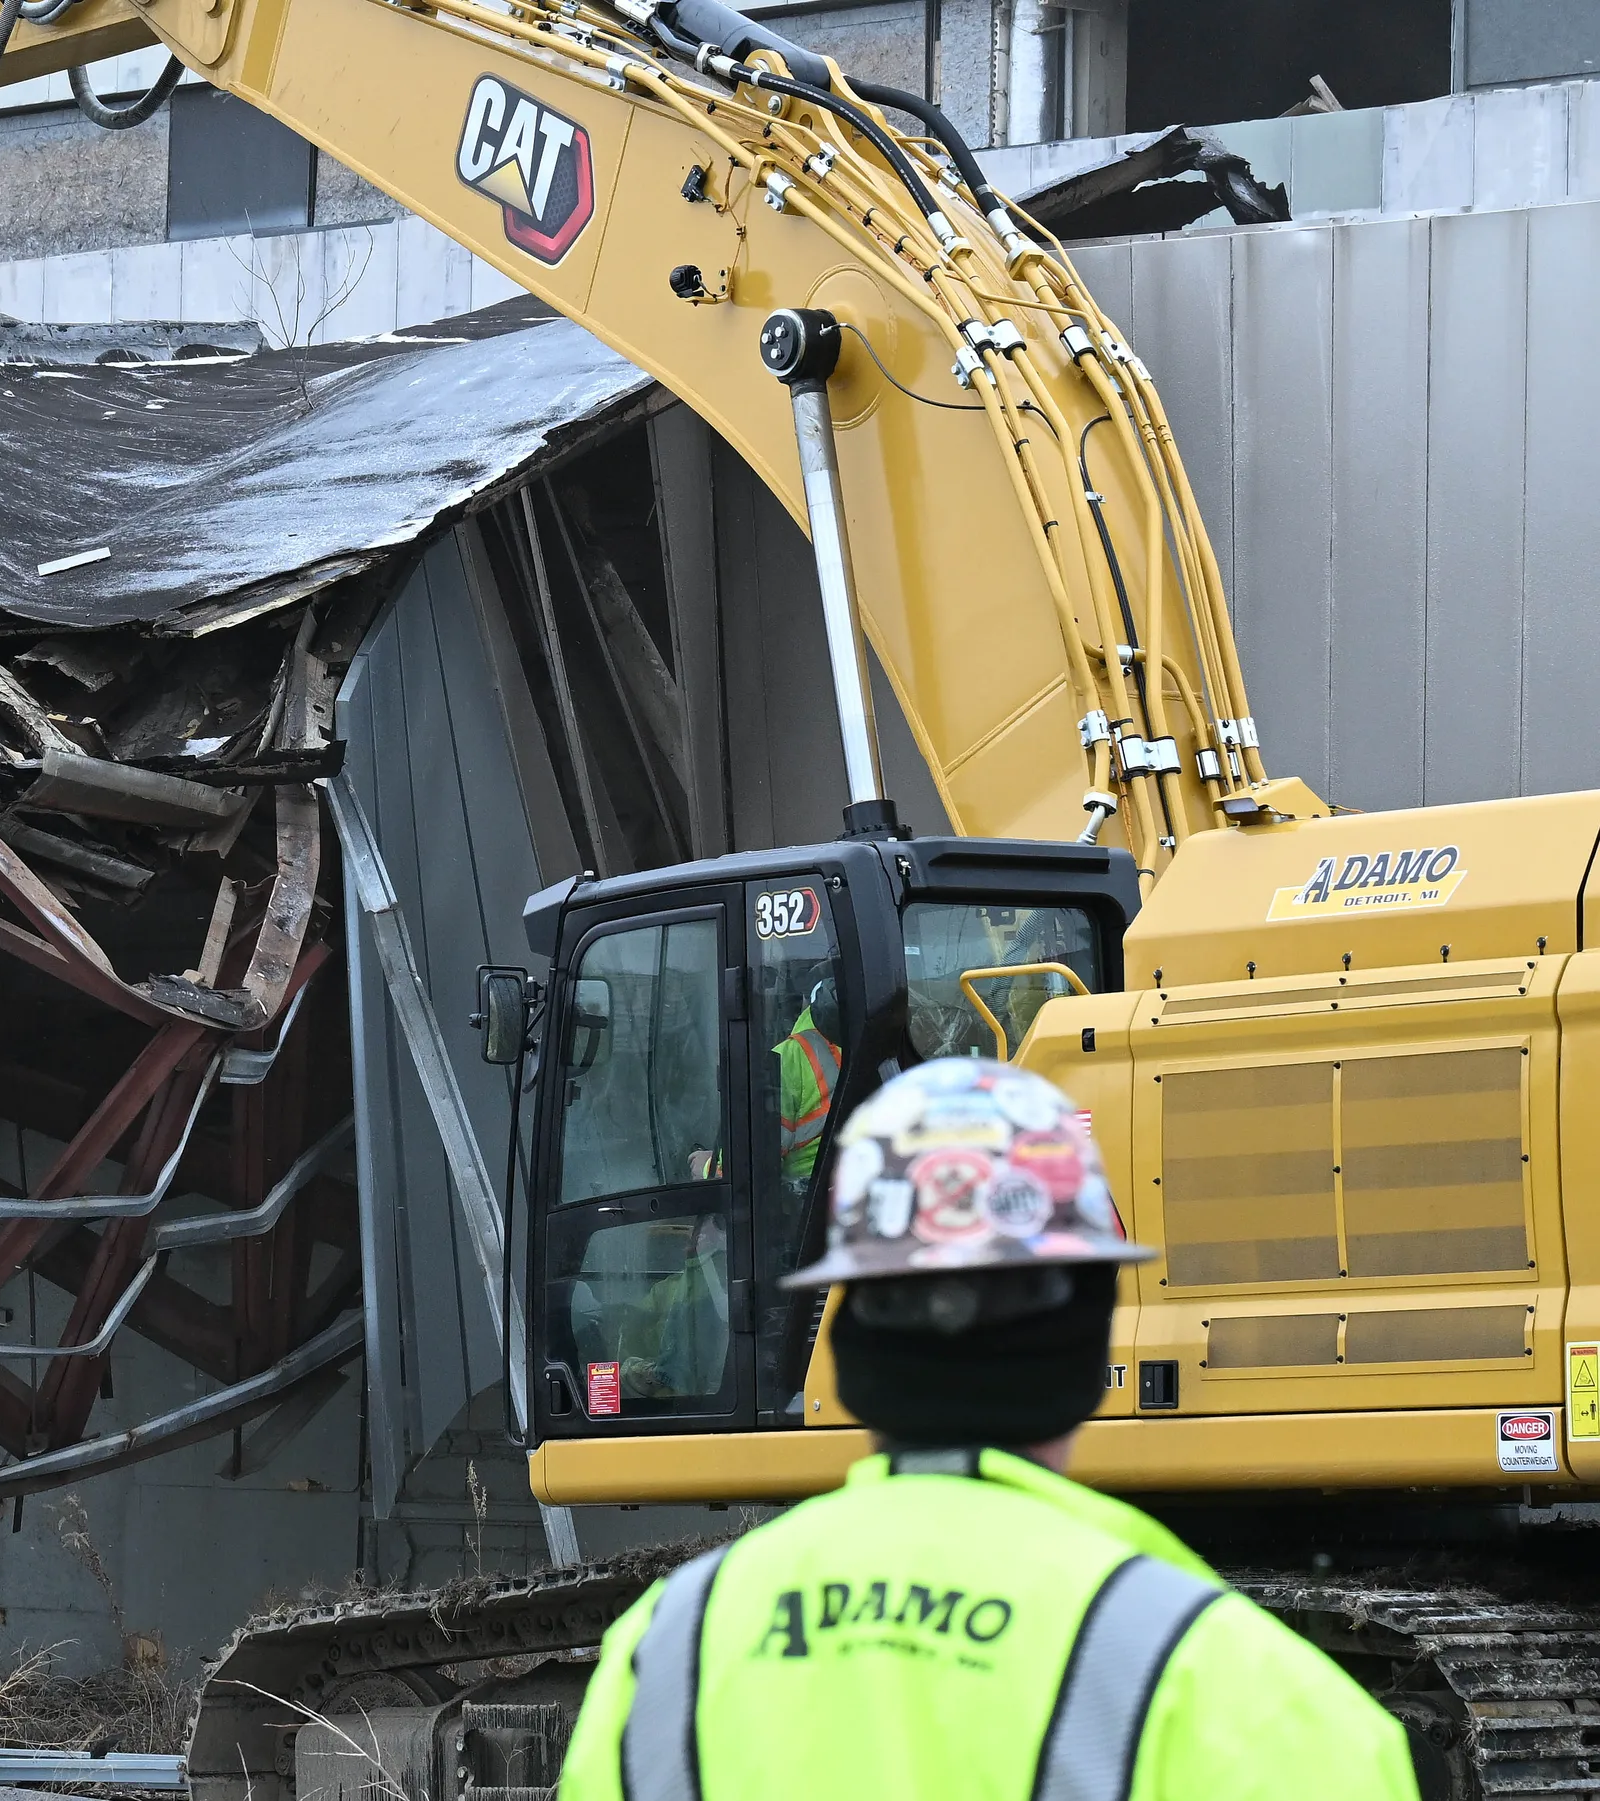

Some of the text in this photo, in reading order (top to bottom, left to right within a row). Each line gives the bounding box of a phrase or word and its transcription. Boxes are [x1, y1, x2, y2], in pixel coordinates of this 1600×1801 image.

[458, 78, 575, 222] CAT
[1292, 847, 1459, 905] ADAMO
[1419, 889, 1439, 900] MI
[756, 891, 805, 935] 352
[1505, 1422, 1546, 1434] DANGER
[1501, 1457, 1553, 1466] COUNTERWEIGHT
[1514, 1445, 1538, 1454] MOVING
[750, 1581, 1013, 1658] ADAMO
